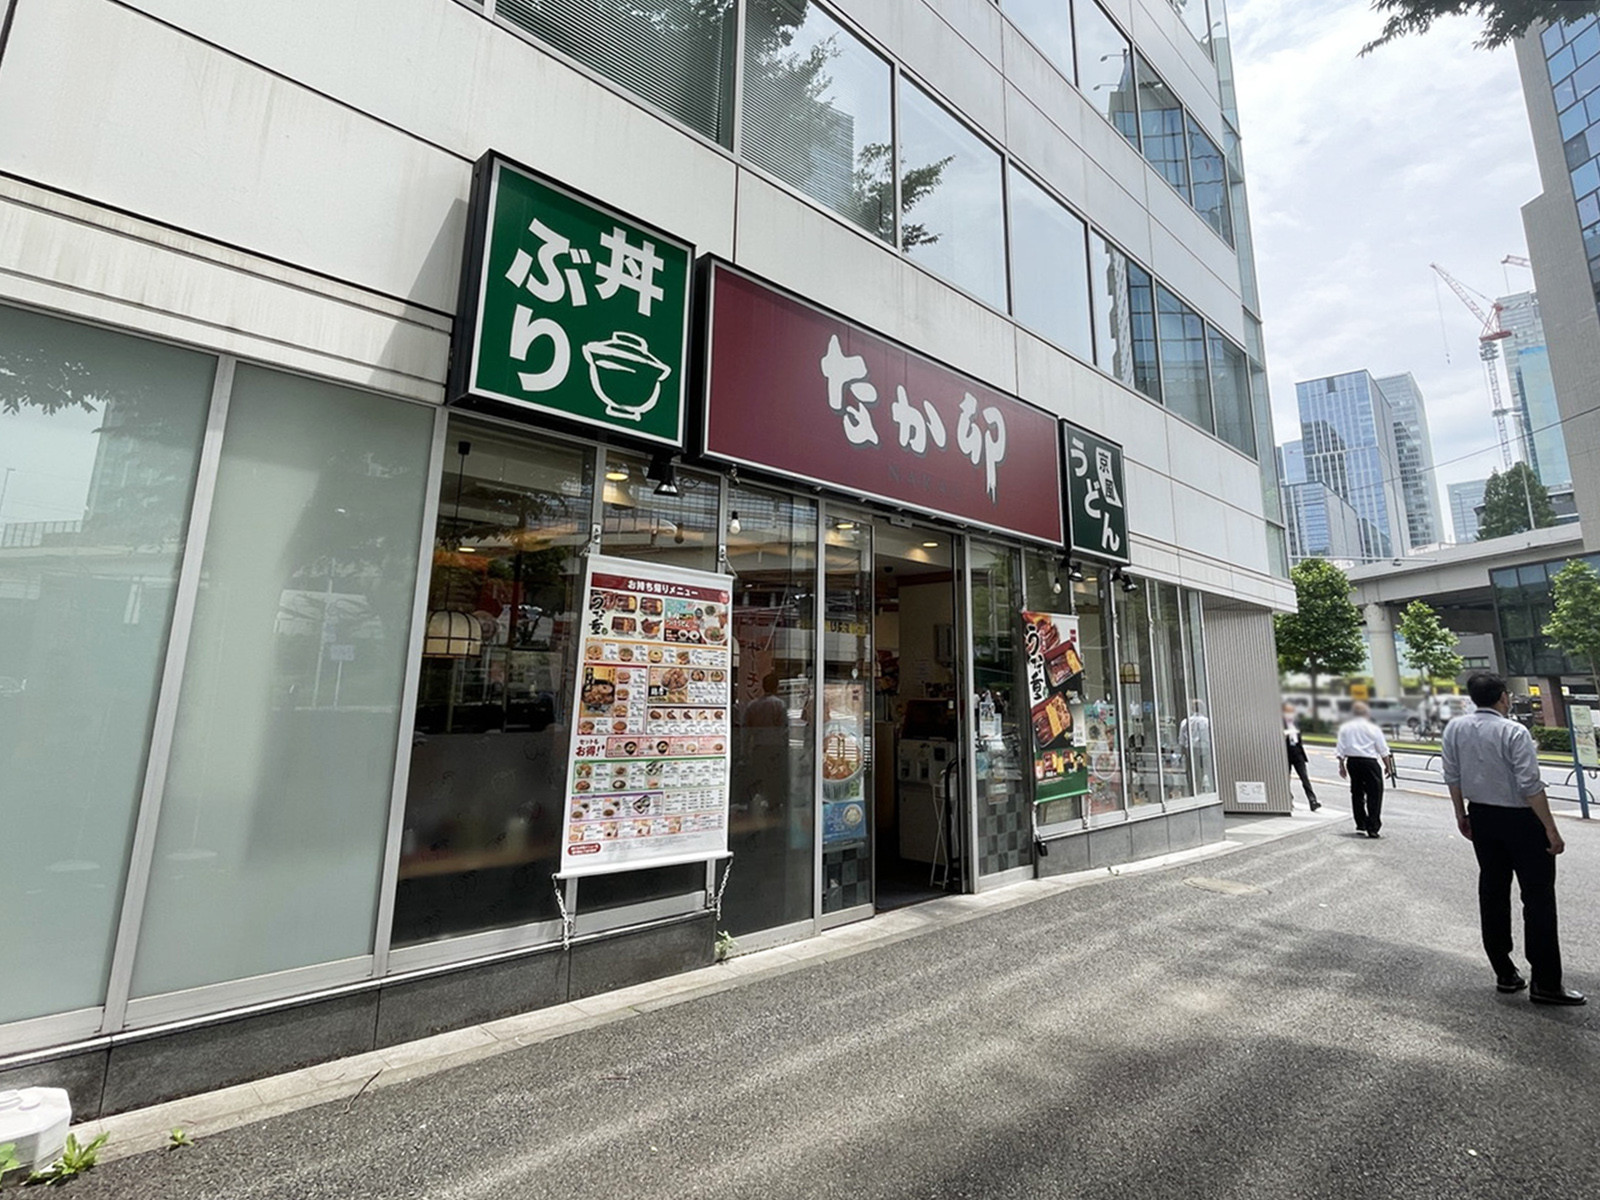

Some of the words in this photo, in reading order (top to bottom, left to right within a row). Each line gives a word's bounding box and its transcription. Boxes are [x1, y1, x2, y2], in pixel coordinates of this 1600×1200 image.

[820, 333, 1007, 503] なか卯
[1070, 437, 1120, 551] うどん
[627, 580, 699, 596] お持ち帰りメニュー
